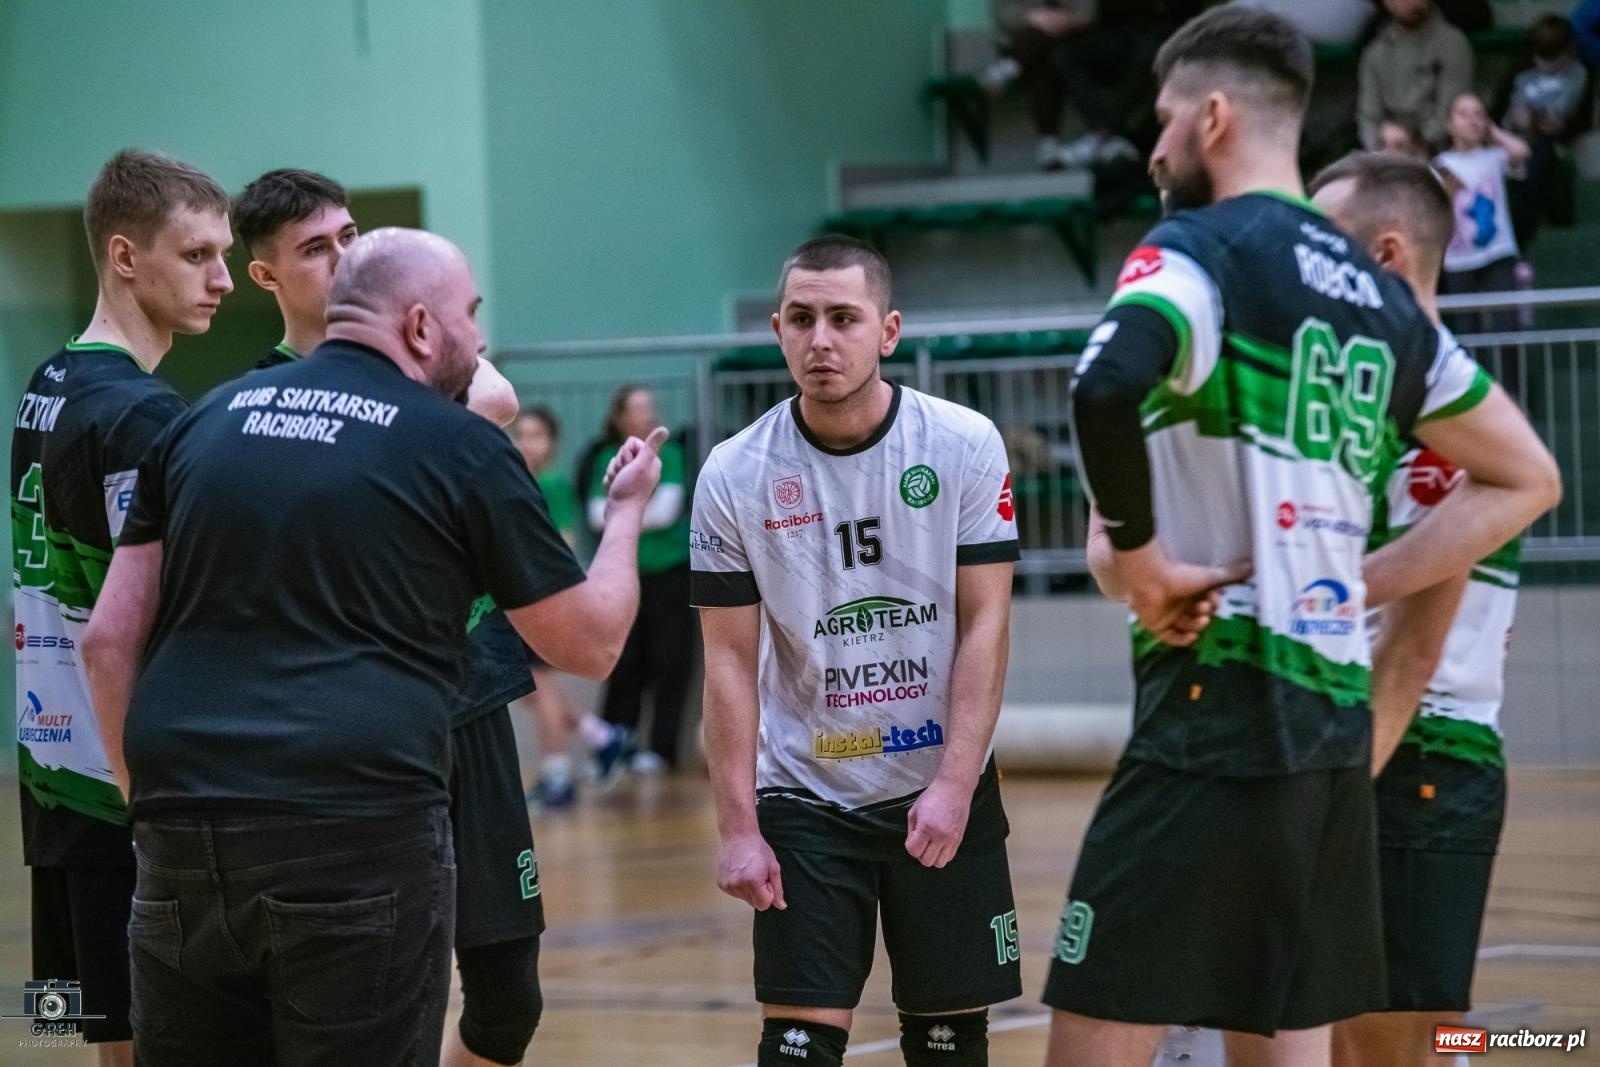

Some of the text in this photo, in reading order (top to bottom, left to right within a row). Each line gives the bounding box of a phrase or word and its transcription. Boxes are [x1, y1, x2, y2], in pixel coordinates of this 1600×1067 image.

[276, 387, 399, 427] SIATKARSKI
[1285, 316, 1397, 484] 69
[242, 410, 344, 444] RACIBÓRZ
[764, 511, 824, 531] Racibórz
[834, 516, 884, 571] 15
[843, 632, 885, 648] KIETRZ
[825, 656, 928, 692] PIVEXIN
[825, 682, 929, 709] TECHNOLOGY
[37, 715, 73, 727] MULTI
[816, 719, 943, 753] instal-tech
[990, 909, 1020, 966] 15
